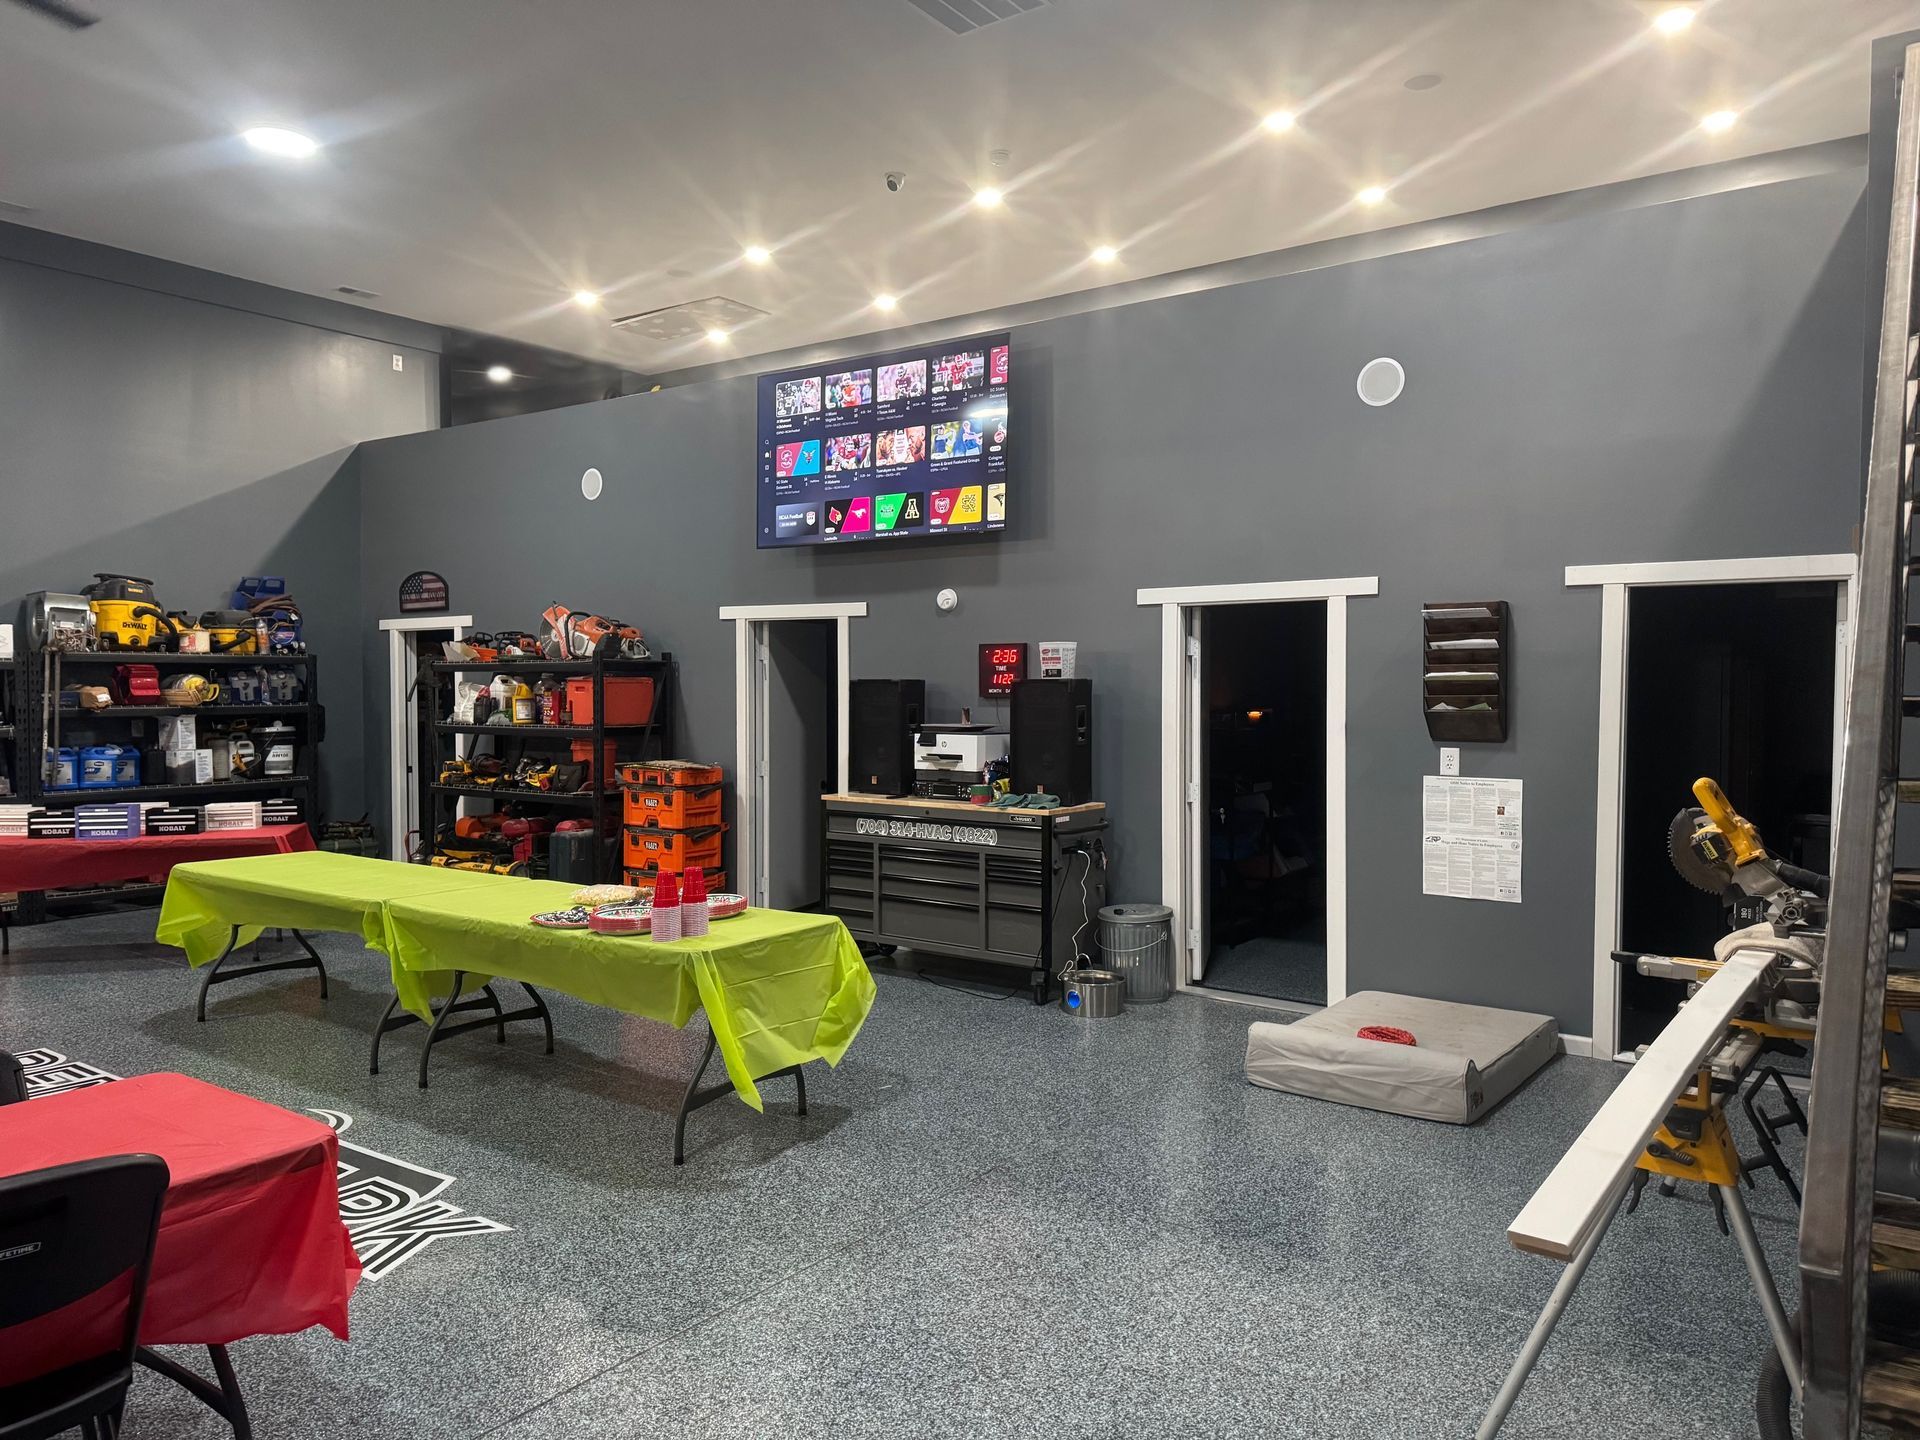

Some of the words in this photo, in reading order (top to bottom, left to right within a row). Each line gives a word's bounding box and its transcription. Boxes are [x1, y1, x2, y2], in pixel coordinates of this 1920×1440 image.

[993, 649, 1018, 663] 2:36
[856, 818, 888, 835] (704)
[889, 820, 952, 840] 314-HVAC
[953, 825, 998, 845] (4822)
